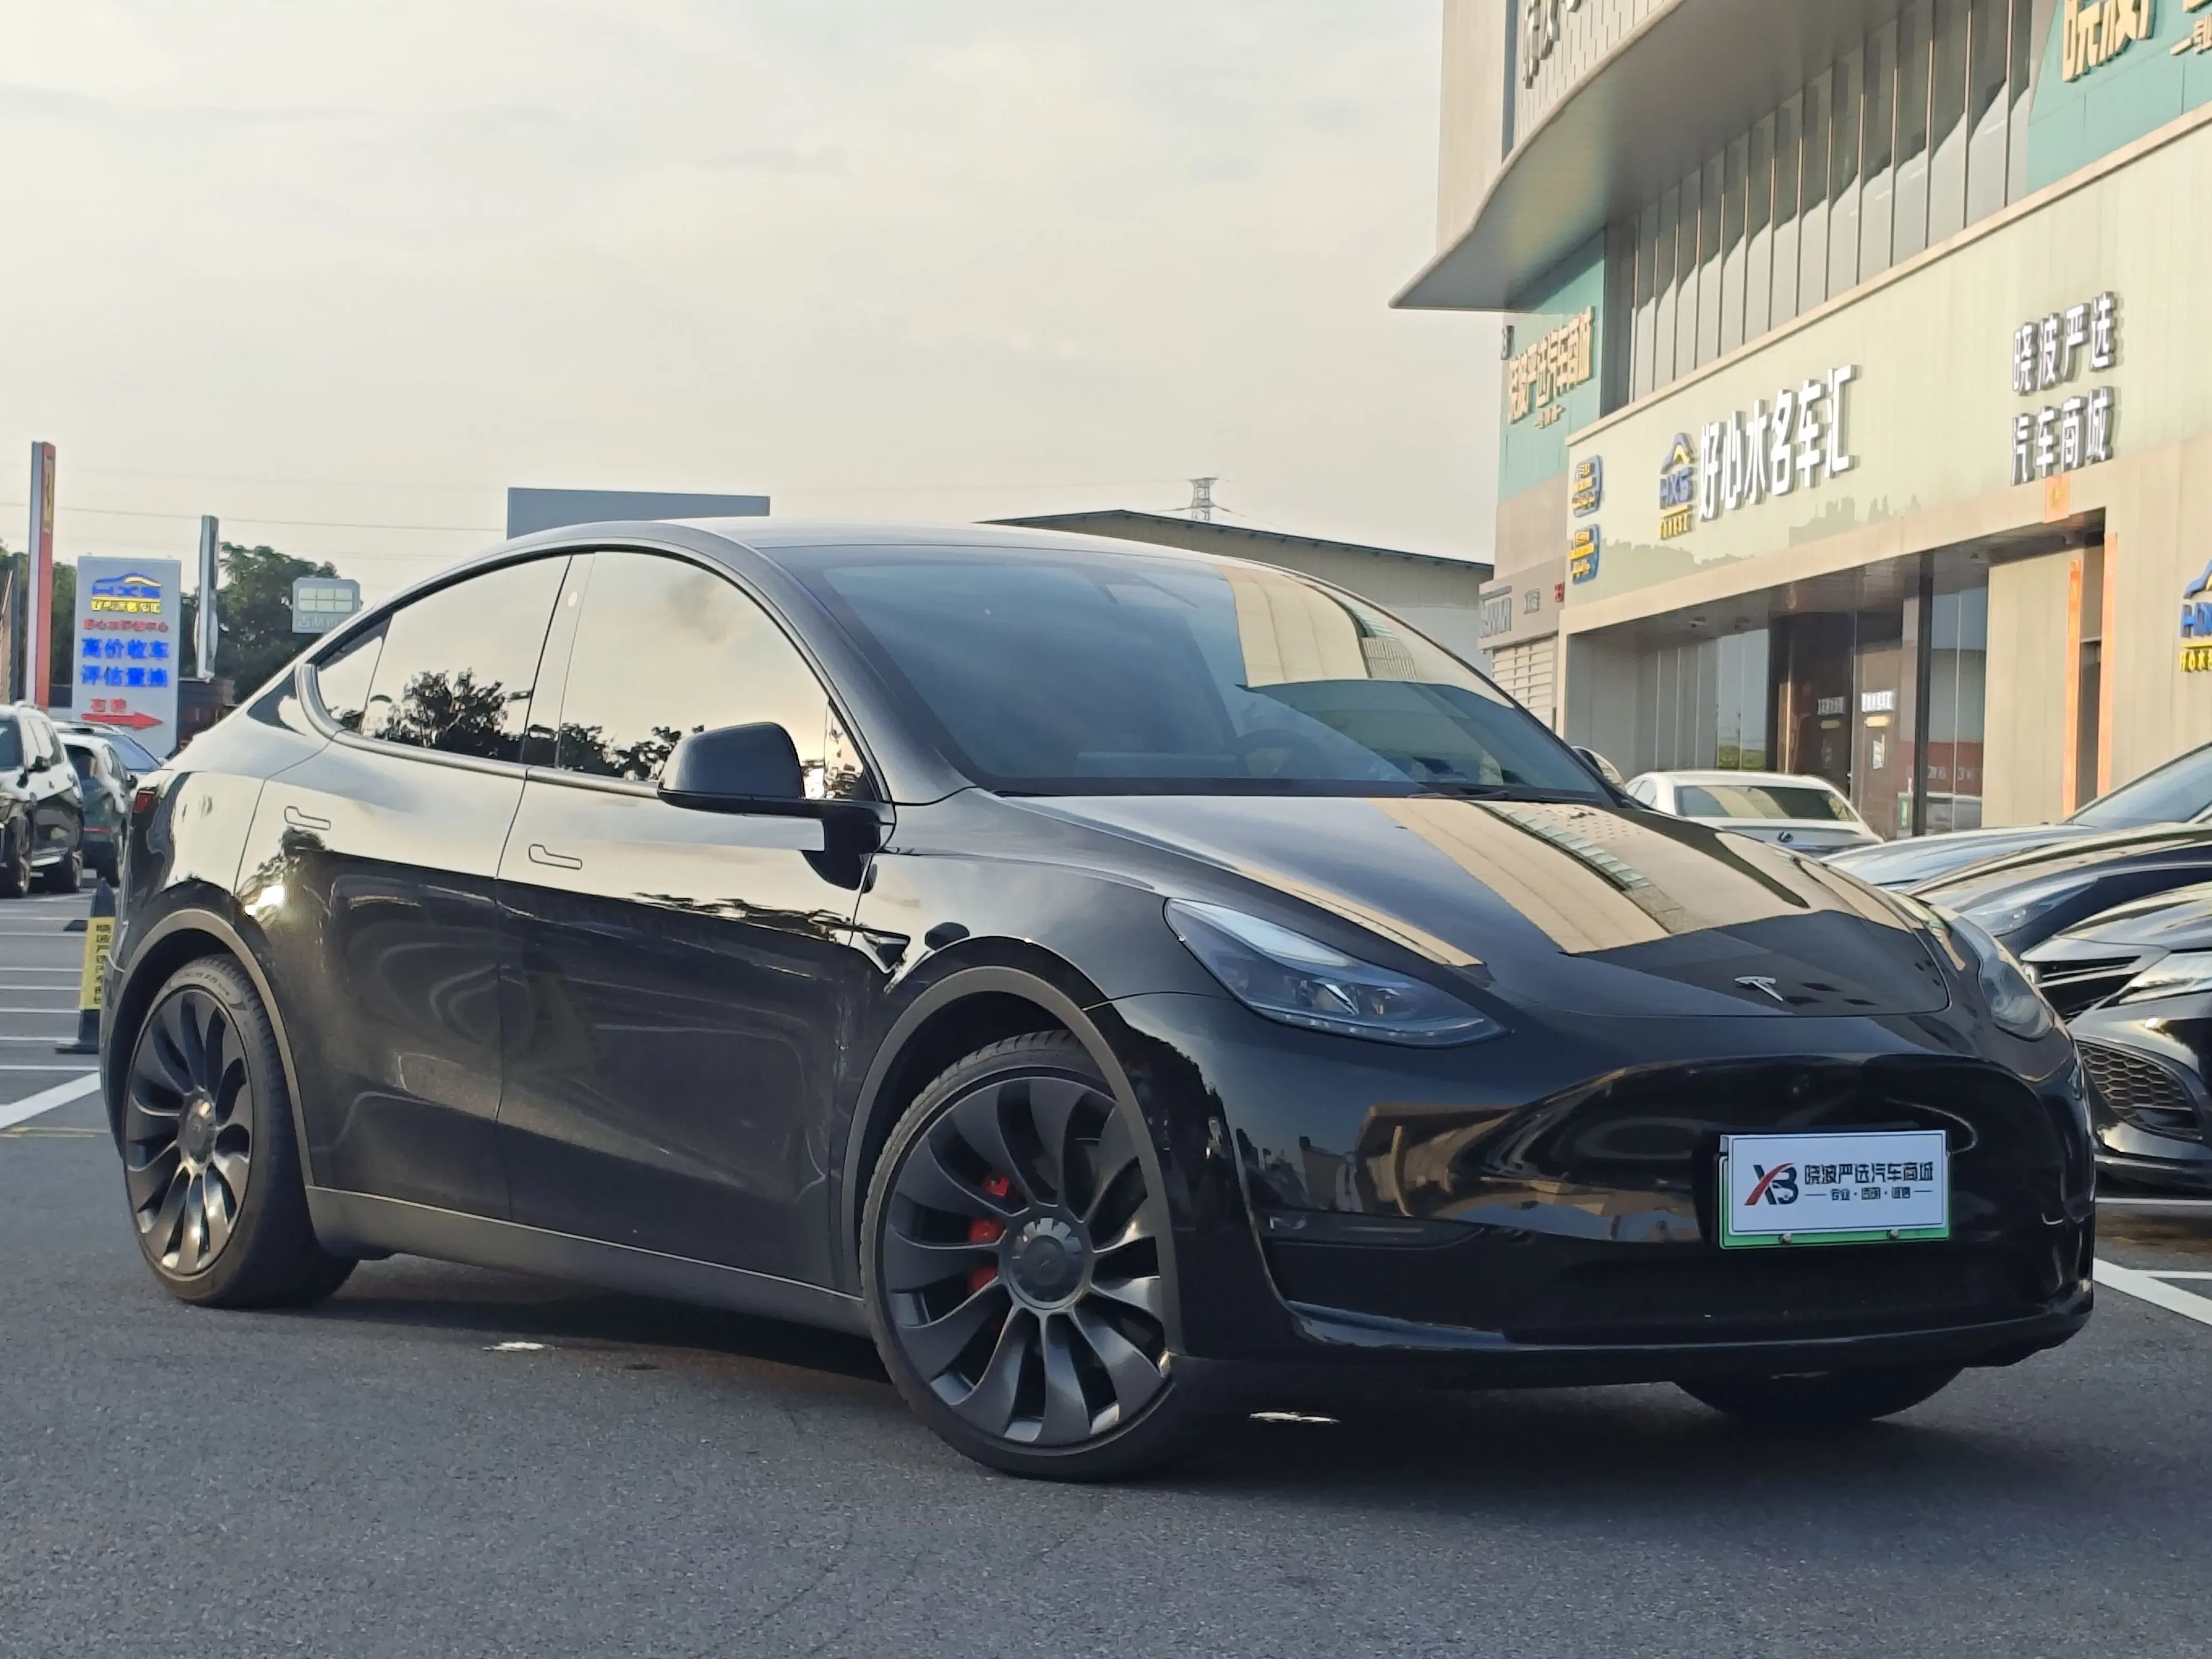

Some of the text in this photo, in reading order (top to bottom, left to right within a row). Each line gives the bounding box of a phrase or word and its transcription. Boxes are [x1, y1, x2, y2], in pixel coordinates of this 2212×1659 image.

[2013, 291, 2114, 395] 晓波严选
[1698, 364, 1857, 522] 好心水名车汇
[2011, 386, 2114, 486] 汽车商城
[82, 637, 168, 660] 高价收车
[1805, 1161, 1933, 1185] 晓波严选汽车商城
